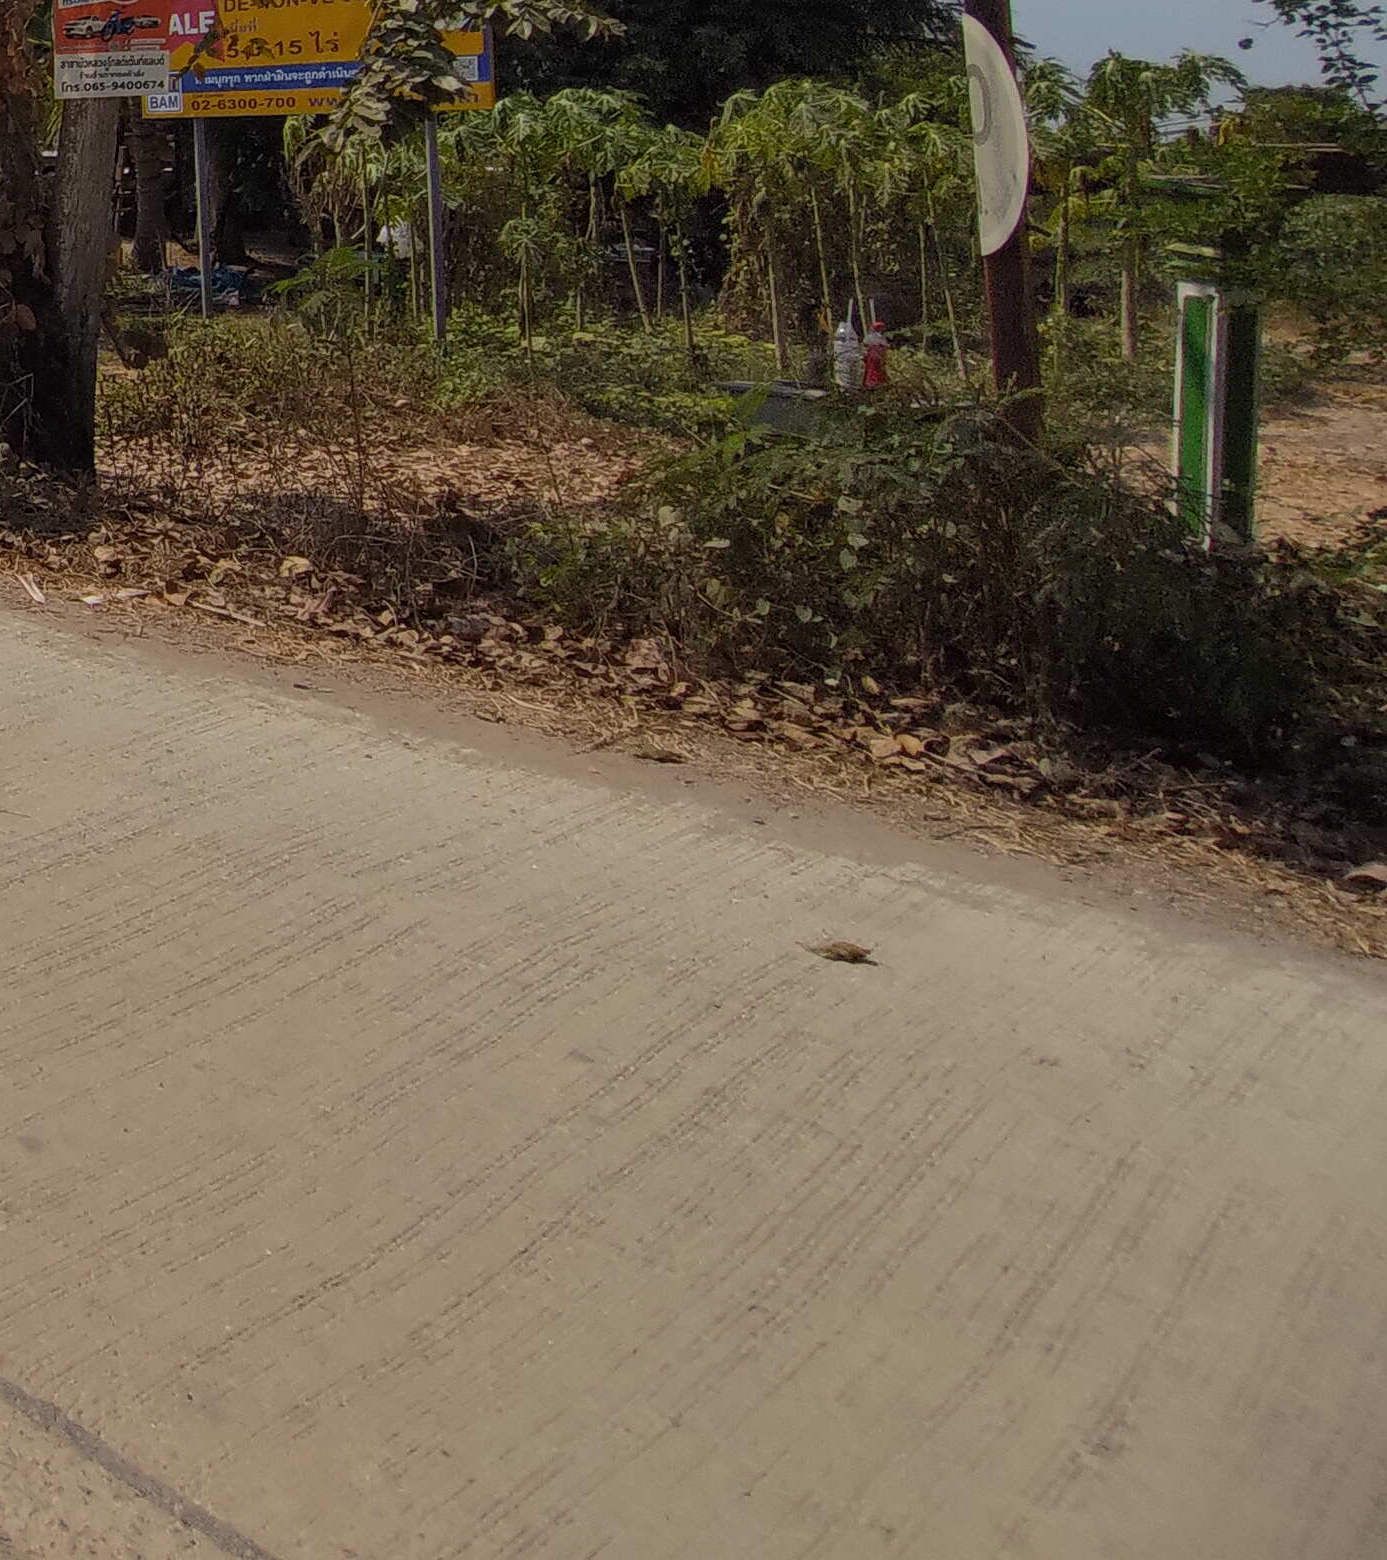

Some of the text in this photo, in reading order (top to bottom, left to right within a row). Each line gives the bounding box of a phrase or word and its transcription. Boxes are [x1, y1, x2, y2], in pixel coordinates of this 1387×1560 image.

[169, 11, 216, 36] ALE
[194, 73, 241, 88] ามบุกรุก
[149, 94, 179, 109] BAM
[191, 97, 296, 112] 02-6300-700
